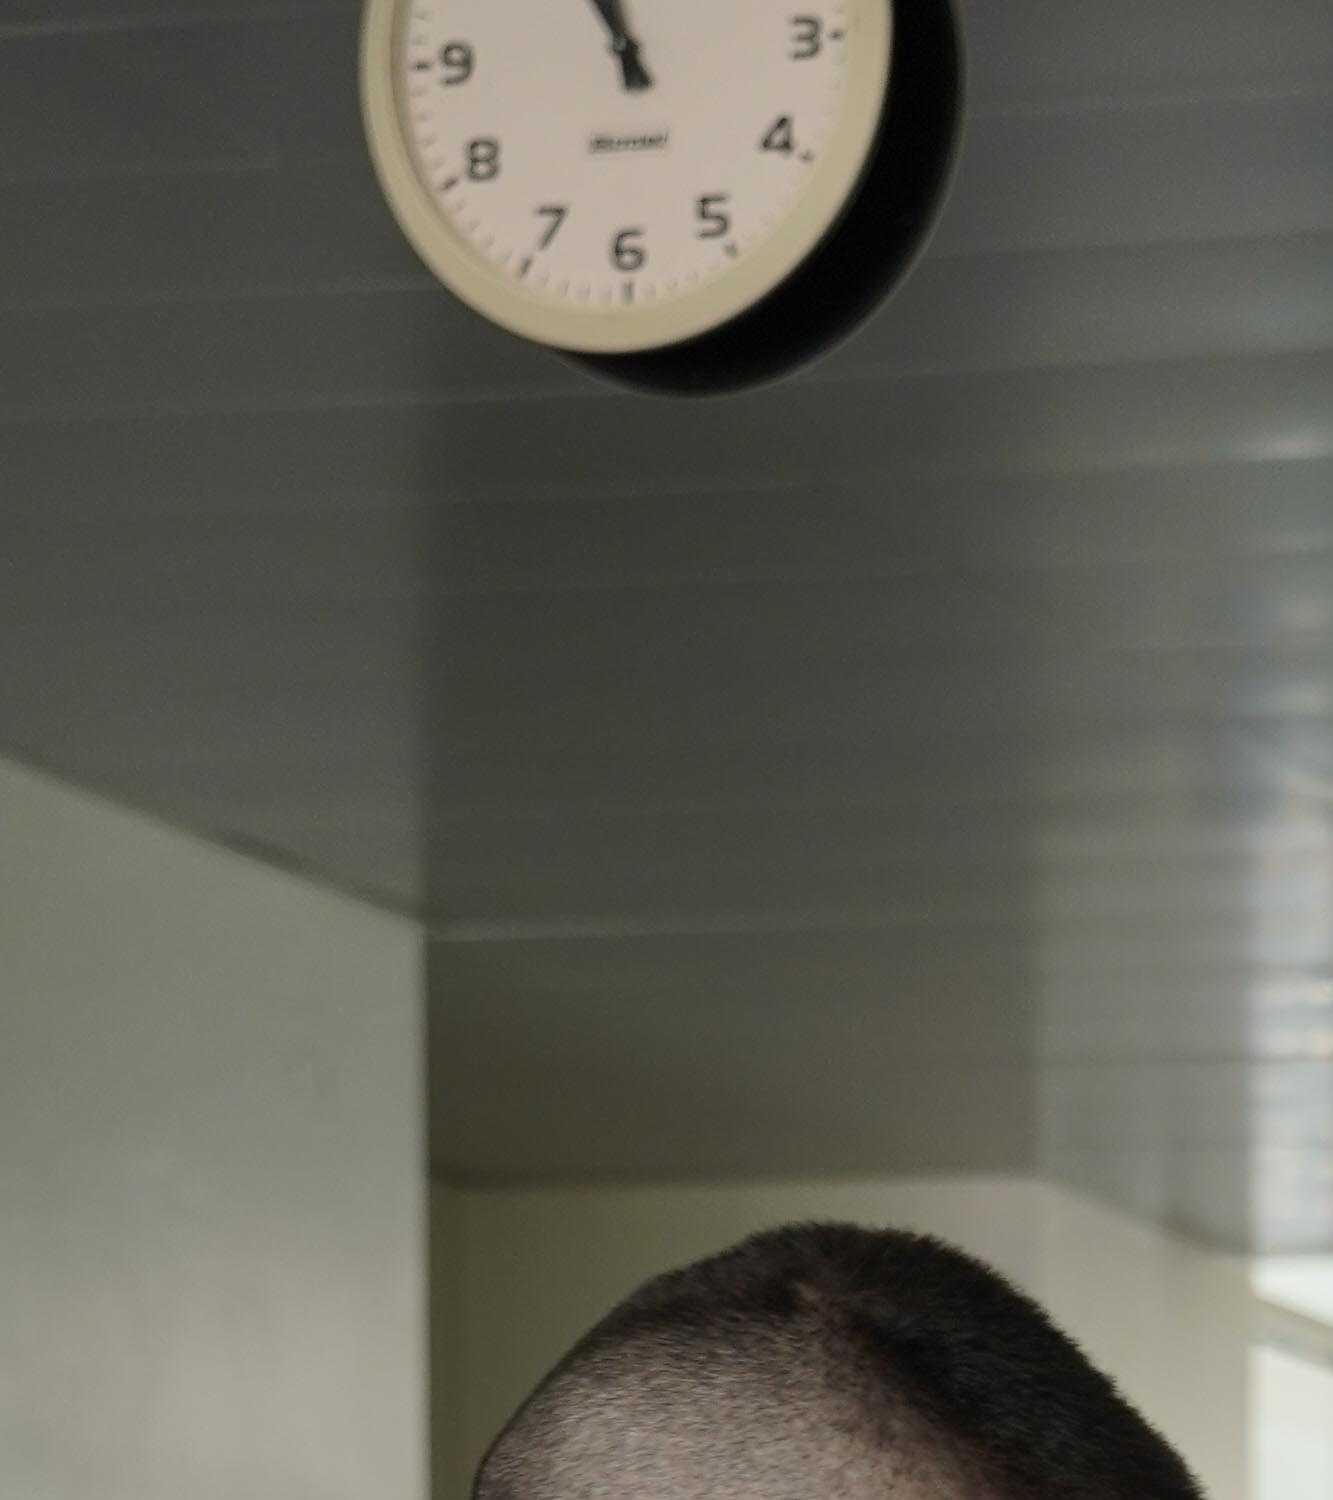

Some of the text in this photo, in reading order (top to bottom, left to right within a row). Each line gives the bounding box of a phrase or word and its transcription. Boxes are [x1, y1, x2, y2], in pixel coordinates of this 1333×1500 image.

[788, 16, 823, 60] 3
[439, 41, 474, 86] 9
[759, 116, 796, 155] 4
[465, 139, 500, 181] 8
[534, 206, 568, 249] 7
[695, 194, 732, 240] 5
[610, 227, 647, 272] 6
